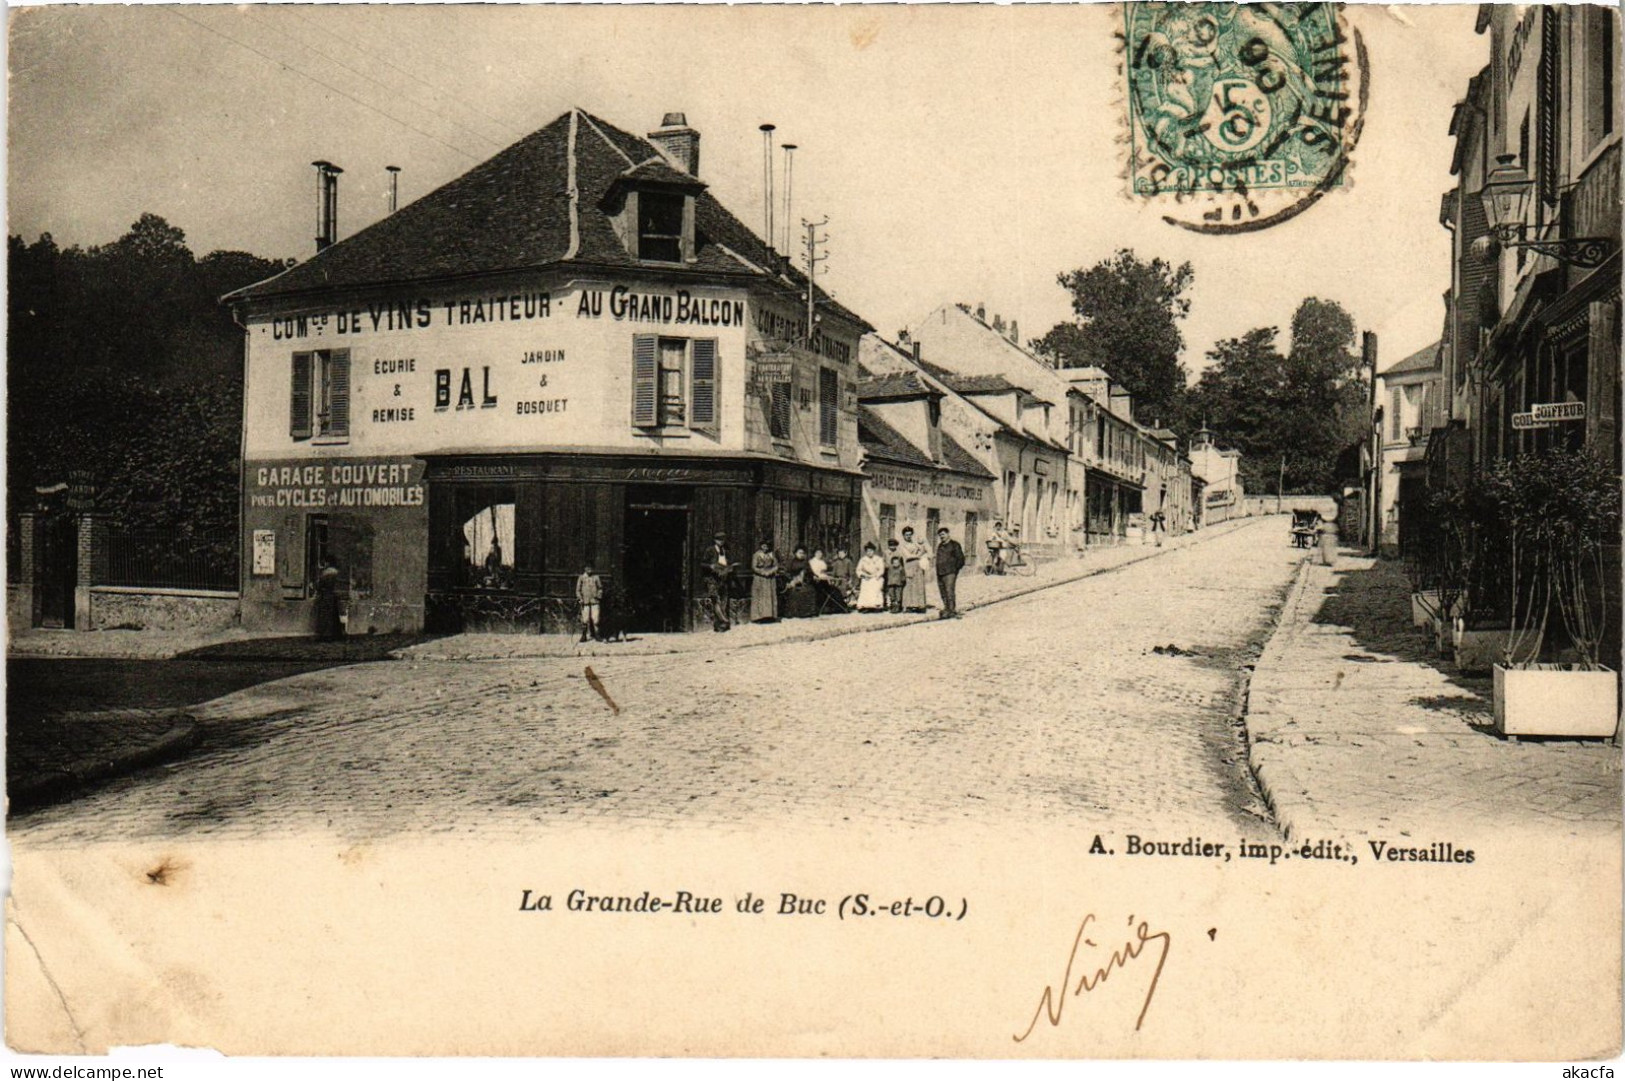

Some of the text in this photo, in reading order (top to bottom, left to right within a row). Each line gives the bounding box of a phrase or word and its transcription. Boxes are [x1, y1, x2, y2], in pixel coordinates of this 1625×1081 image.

[1193, 153, 1283, 188] POSTES
[337, 310, 361, 334] DE
[367, 299, 432, 332] VINS
[447, 293, 551, 326] TRAITEUR
[576, 285, 744, 327] AU GRAND BALCON
[521, 350, 566, 364] JARDIN
[374, 358, 416, 375] ÉCURIE
[435, 366, 497, 409] BAL
[540, 374, 549, 387] &
[393, 384, 402, 396] &
[373, 408, 415, 423] REMISE
[516, 399, 568, 415] BOSQUET
[1535, 404, 1584, 419] COIFFEUR
[258, 464, 412, 486] GARAGE COUVERT
[251, 485, 424, 507] POUR CYCLES et AUTOMOBILES
